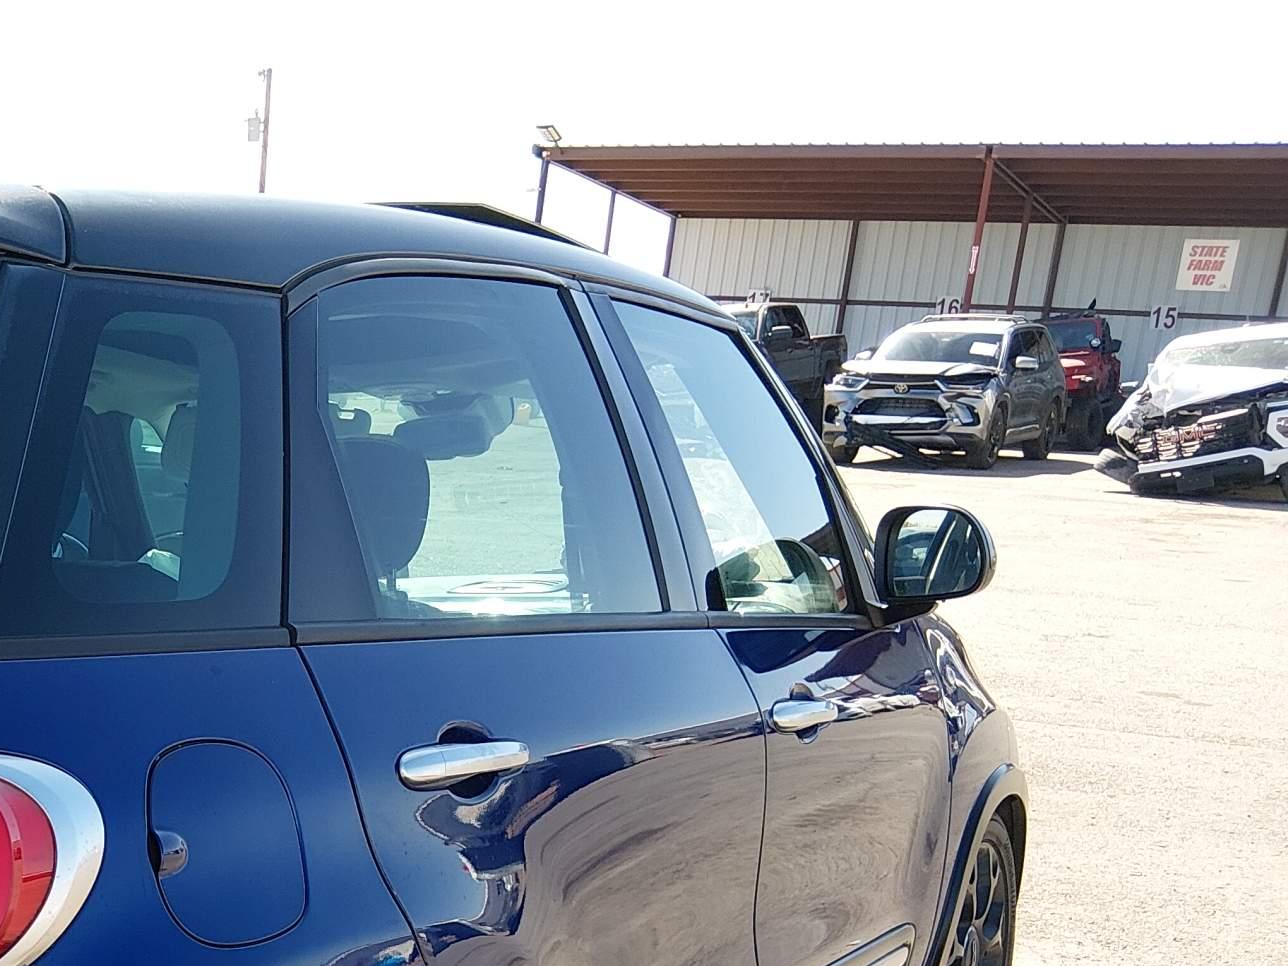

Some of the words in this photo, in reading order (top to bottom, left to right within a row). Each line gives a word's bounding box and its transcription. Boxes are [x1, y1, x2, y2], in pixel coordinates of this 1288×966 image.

[1189, 245, 1230, 257] STATE
[1187, 259, 1225, 272] FARM
[1192, 274, 1216, 286] VIC
[937, 298, 960, 315] 16
[1152, 306, 1177, 329] 15
